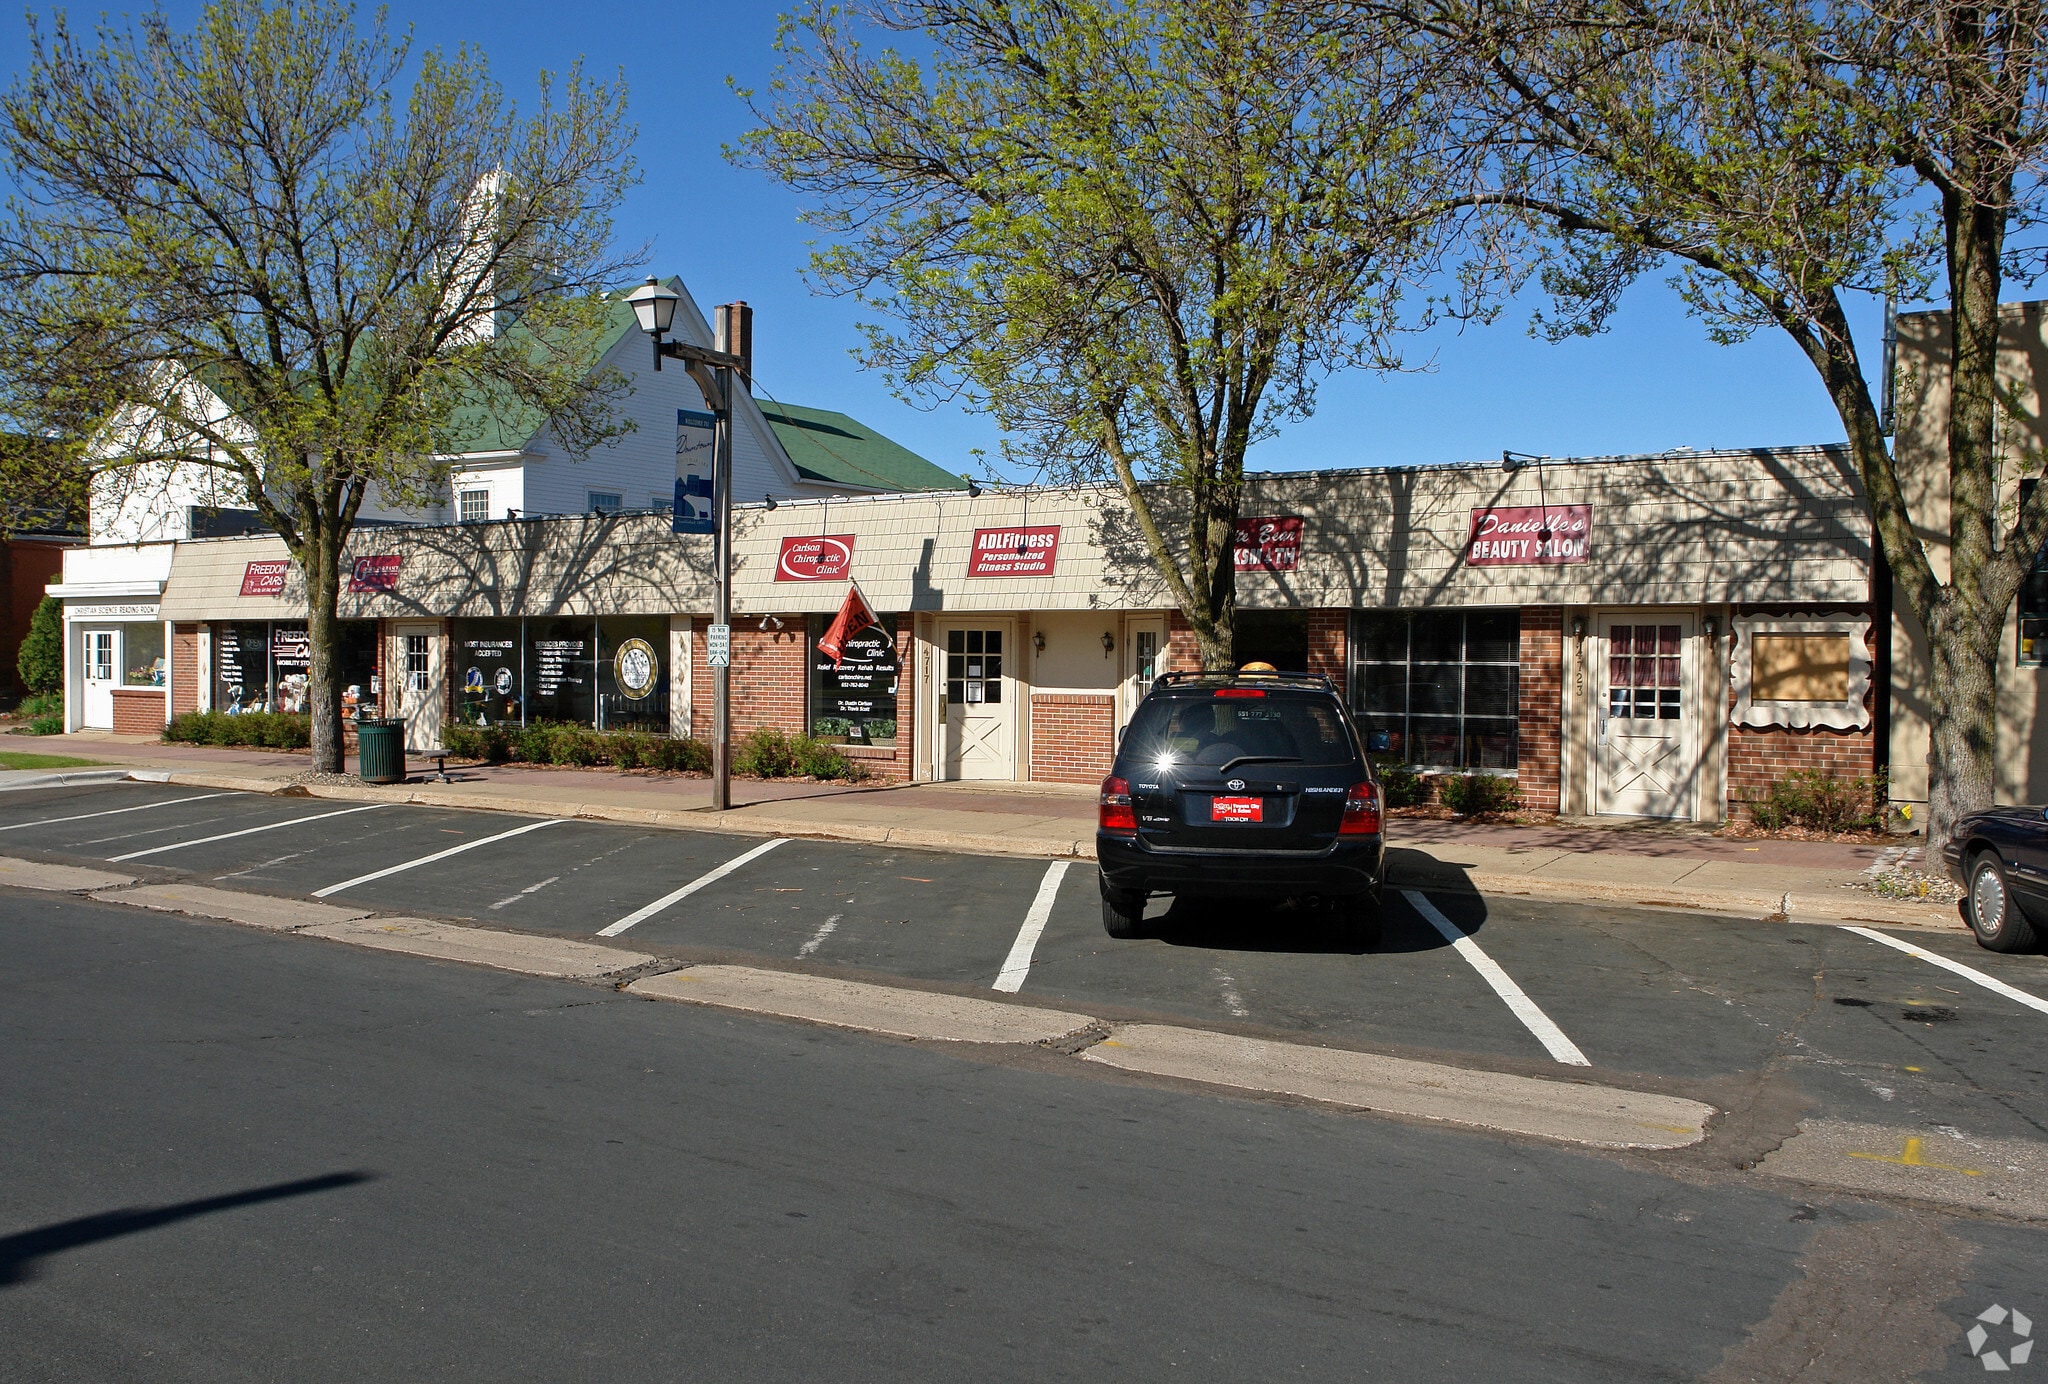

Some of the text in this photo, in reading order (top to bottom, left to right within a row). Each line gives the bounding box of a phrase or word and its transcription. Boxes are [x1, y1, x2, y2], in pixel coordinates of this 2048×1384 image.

[676, 434, 713, 454] Downtown
[1477, 513, 1585, 536] Danielle's
[1258, 523, 1296, 544] Bear
[977, 532, 1055, 549] ADLFitness
[792, 543, 820, 552] Carlson
[1472, 539, 1585, 559] BEAUTY SALON
[793, 554, 841, 565] Chiropctic
[249, 563, 288, 575] FREEDOM
[816, 565, 840, 574] Clinic
[977, 561, 1047, 572] Fitness Studio
[260, 575, 284, 586] CARS
[75, 605, 155, 615] CHRISTIAN SCIENCE READING ROOM
[866, 648, 885, 657] Clinic
[923, 647, 931, 684] 4717
[1575, 650, 1583, 697] 4723
